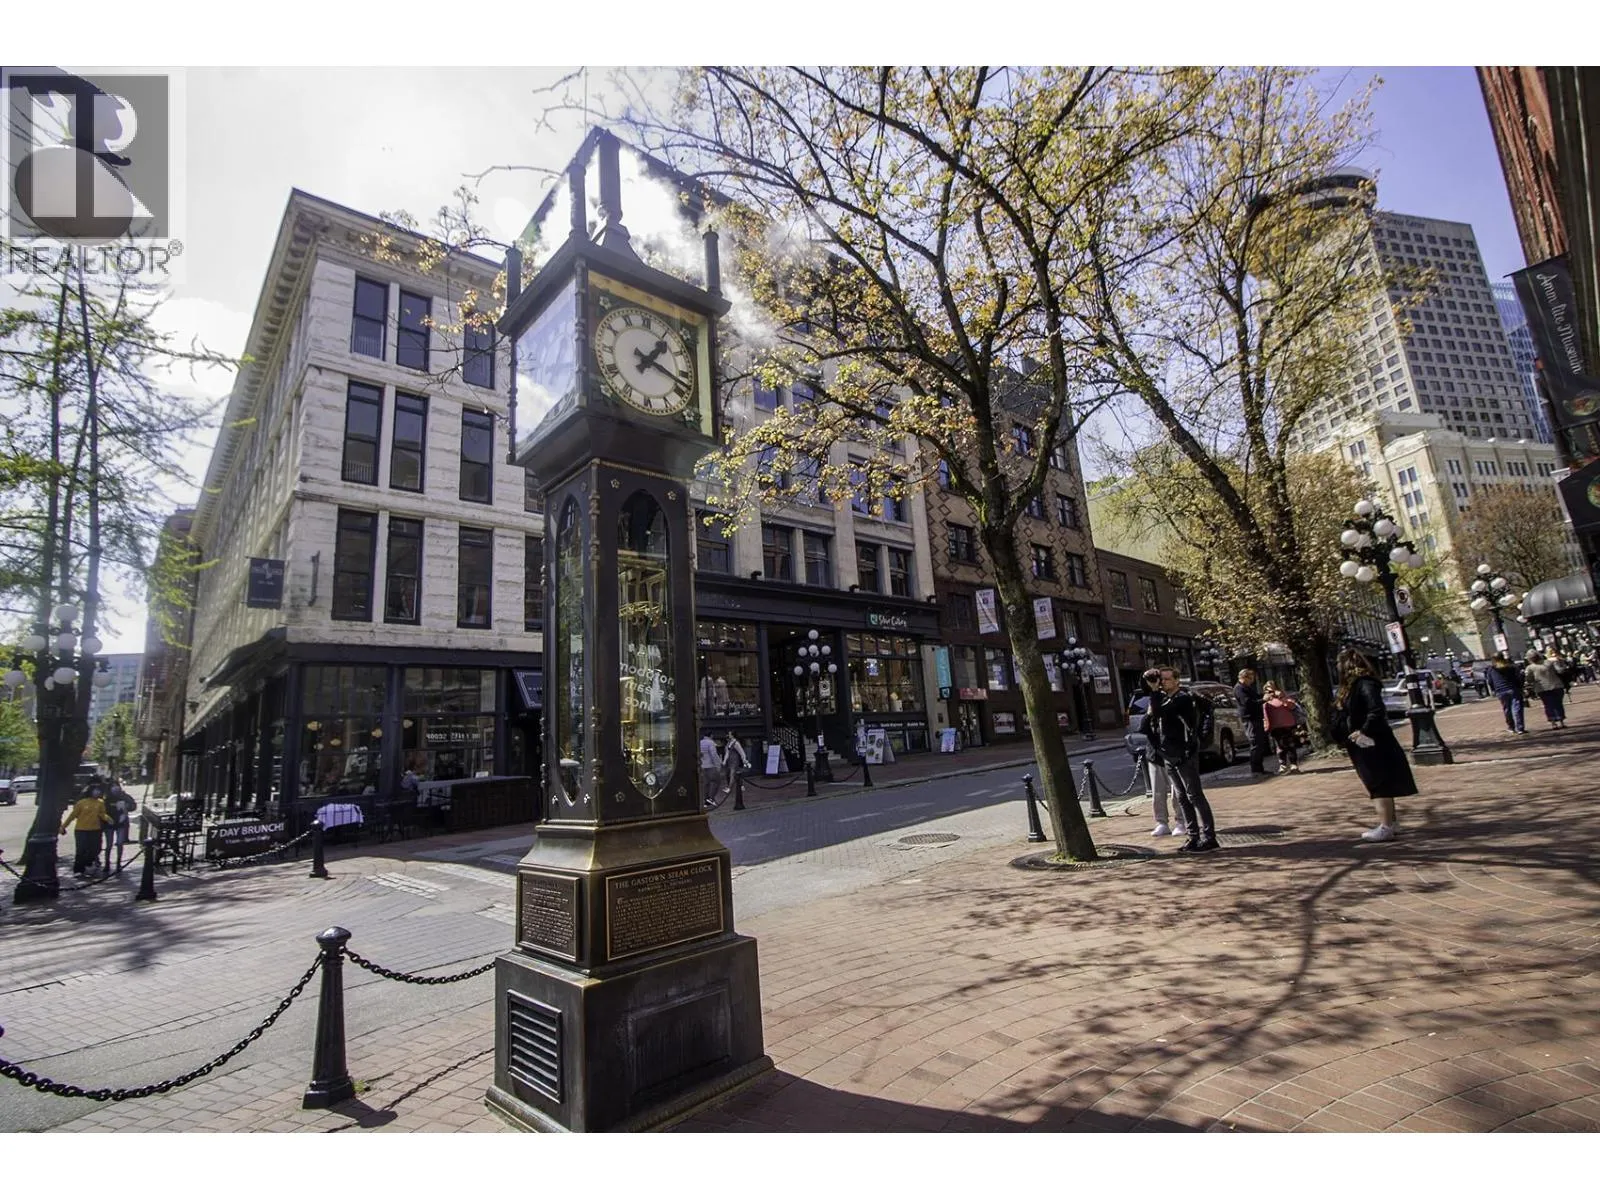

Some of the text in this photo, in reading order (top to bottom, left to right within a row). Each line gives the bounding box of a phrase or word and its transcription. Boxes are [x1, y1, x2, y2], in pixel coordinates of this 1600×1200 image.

[1558, 320, 1586, 375] Museum
[211, 829, 218, 839] 7
[220, 827, 240, 838] DAY
[615, 880, 630, 889] THE
[631, 873, 666, 887] GASTOWN
[690, 864, 713, 875] CLOCK
